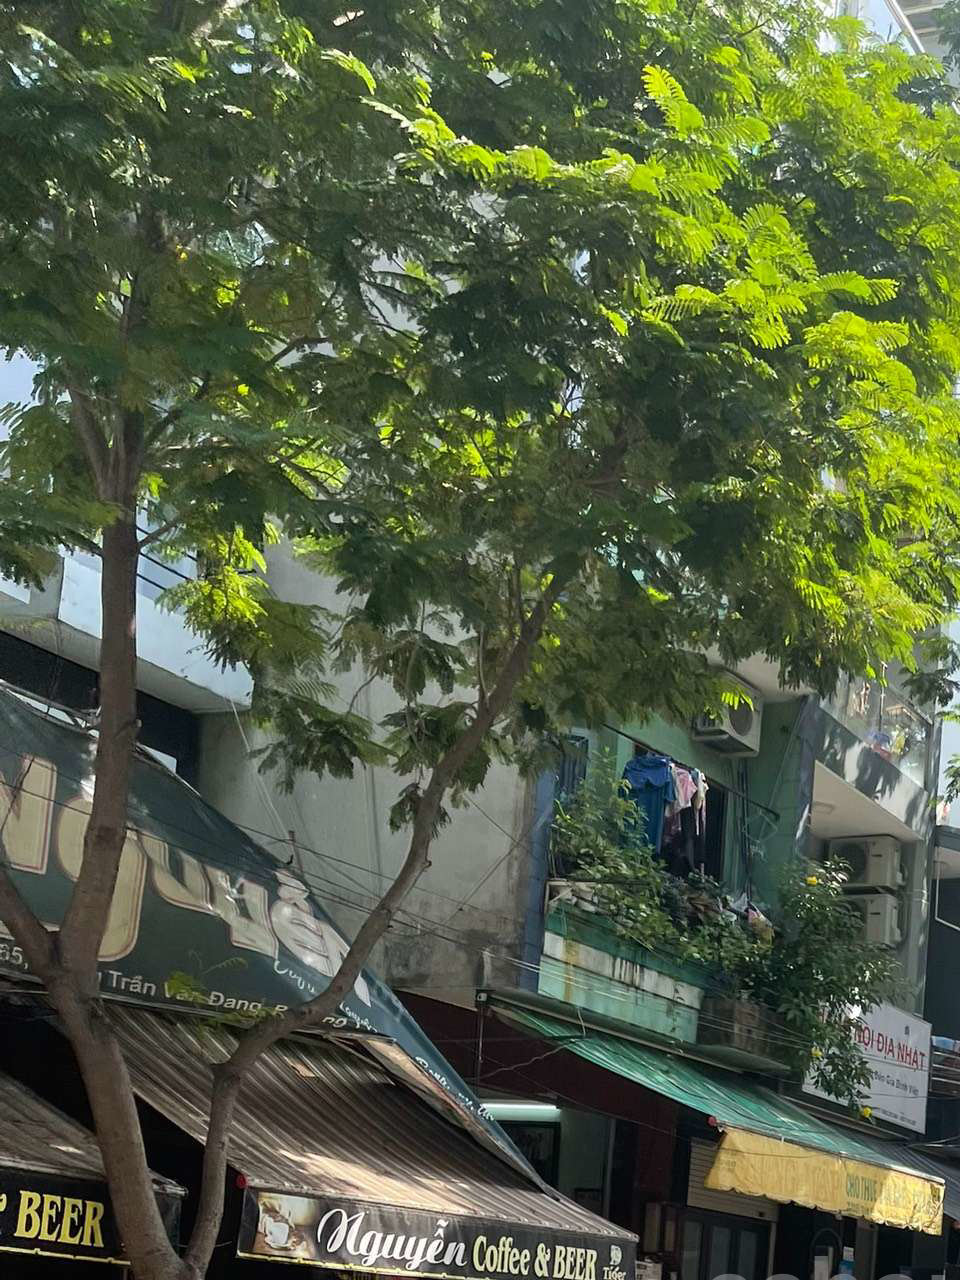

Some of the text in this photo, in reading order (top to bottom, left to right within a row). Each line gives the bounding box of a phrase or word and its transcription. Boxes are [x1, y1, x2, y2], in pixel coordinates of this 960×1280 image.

[109, 970, 157, 996] Trần
[14, 1190, 105, 1248] BEER
[317, 1207, 468, 1270] Nguyễn
[473, 1235, 531, 1276] Coffee
[534, 1243, 551, 1278] &
